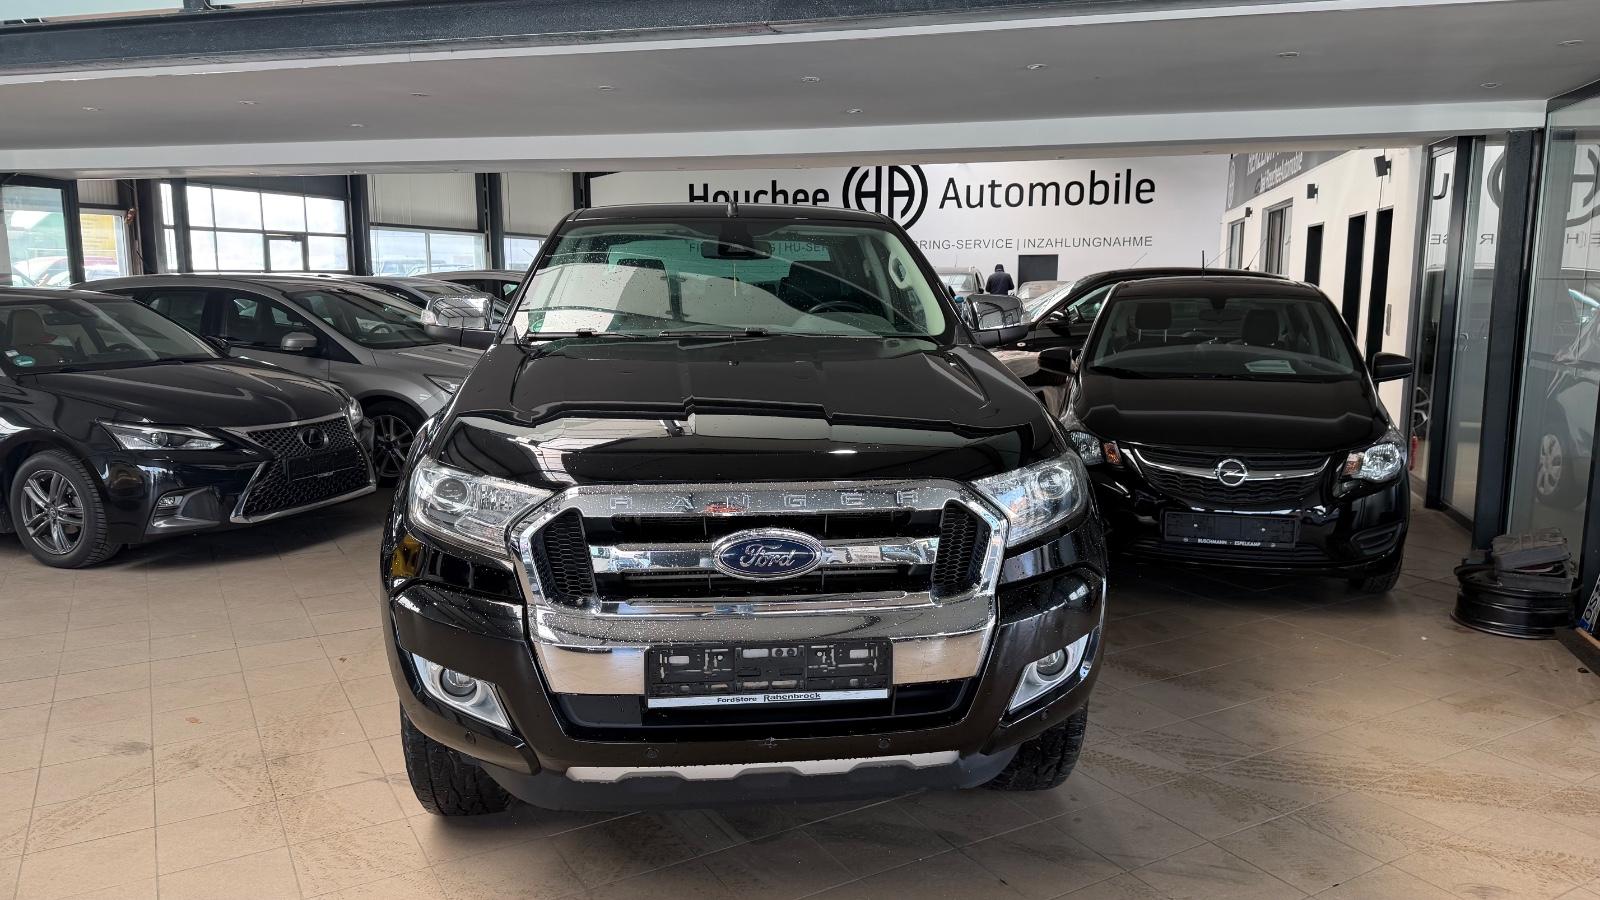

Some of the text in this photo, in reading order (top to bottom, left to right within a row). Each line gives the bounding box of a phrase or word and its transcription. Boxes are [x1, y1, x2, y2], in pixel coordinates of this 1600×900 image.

[939, 168, 1156, 209] Automobile
[1023, 235, 1153, 249] INZAHLUNGNAHME
[610, 491, 919, 512] RANGER
[739, 544, 797, 568] Ford
[763, 692, 821, 702] Rahenbrock
